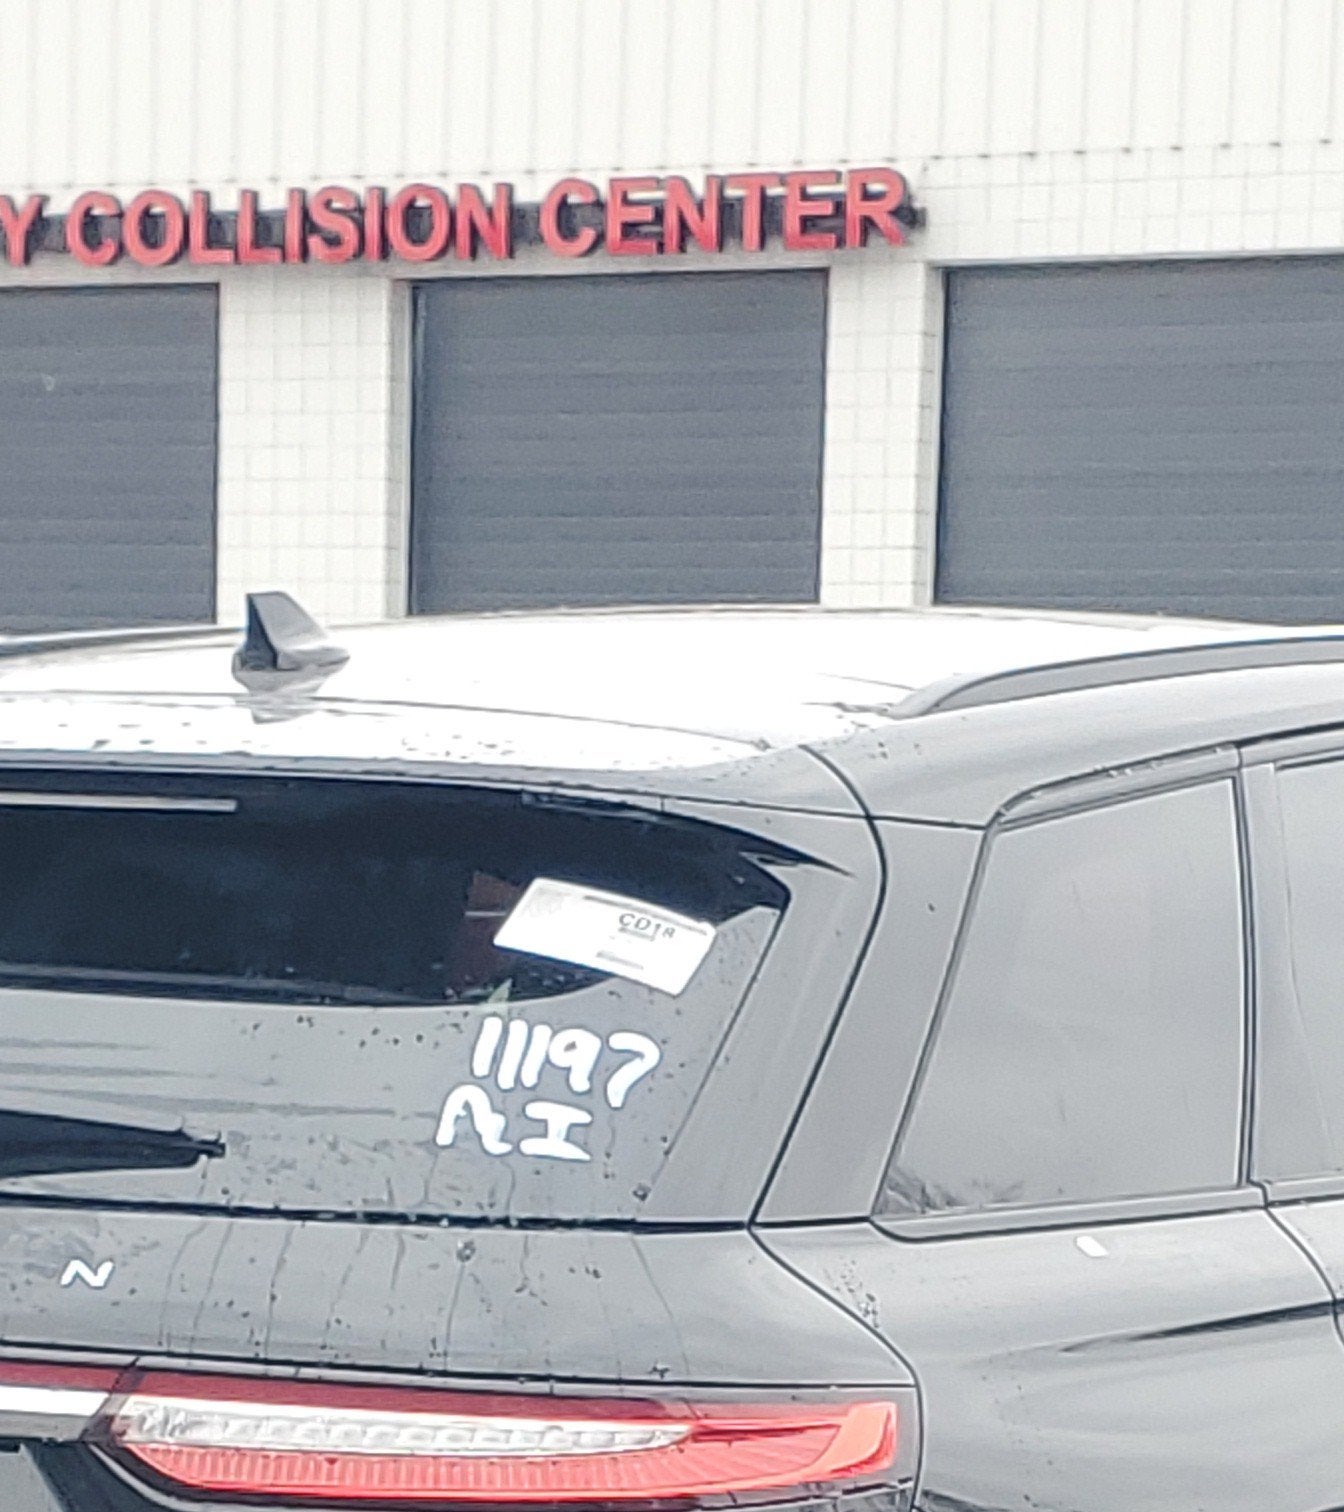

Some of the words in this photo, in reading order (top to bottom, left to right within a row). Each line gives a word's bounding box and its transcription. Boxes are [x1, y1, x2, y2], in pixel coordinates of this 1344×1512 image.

[65, 182, 514, 268] COLLISION
[538, 166, 910, 258] CENTER
[471, 1016, 662, 1109] 11197
